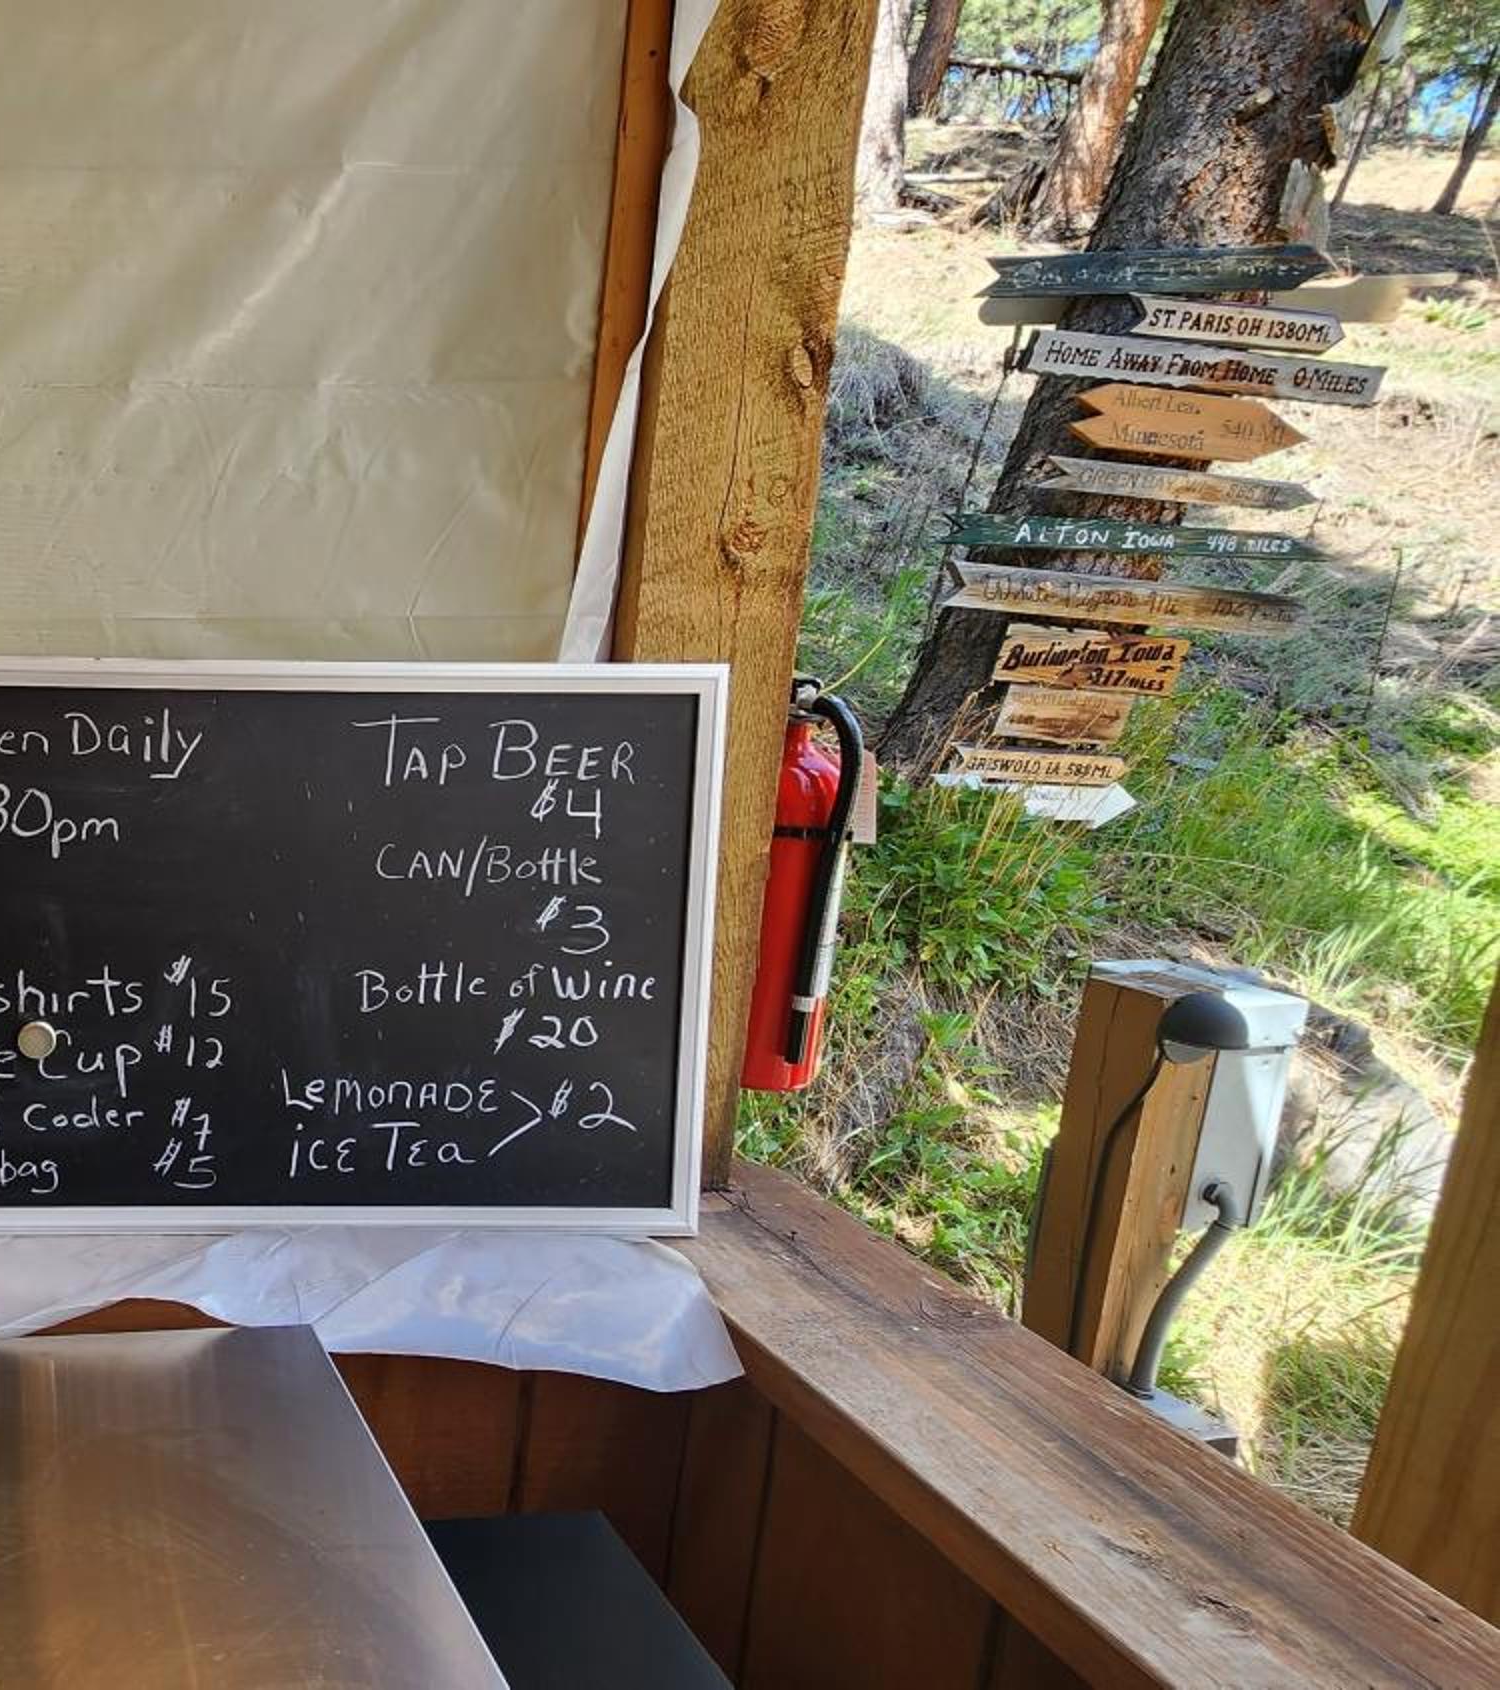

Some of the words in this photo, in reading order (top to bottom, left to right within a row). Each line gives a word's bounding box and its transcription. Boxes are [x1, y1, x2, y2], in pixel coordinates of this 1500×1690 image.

[1237, 316, 1263, 336] OH
[1044, 340, 1102, 368] HOME
[1104, 346, 1161, 374] AWAY
[1163, 350, 1219, 381] FROM
[1221, 359, 1278, 386] HOME
[1013, 523, 1110, 546] ALTON
[1120, 527, 1176, 549] IOWA
[1115, 641, 1176, 664] Iowa
[64, 708, 203, 779] Daily
[351, 713, 468, 786] TAP
[488, 719, 635, 785] BEER
[530, 779, 602, 840] $4
[535, 896, 611, 955] $3
[163, 954, 234, 1019] $15
[354, 961, 488, 1012] Bottle
[509, 964, 545, 999] of
[551, 960, 655, 1000] Wine
[154, 1025, 224, 1069] $12
[493, 1007, 599, 1055] $20
[171, 1097, 213, 1151] $7
[547, 1077, 637, 1132] $2
[0, 1149, 60, 1193] bag
[153, 1138, 218, 1188] $5
